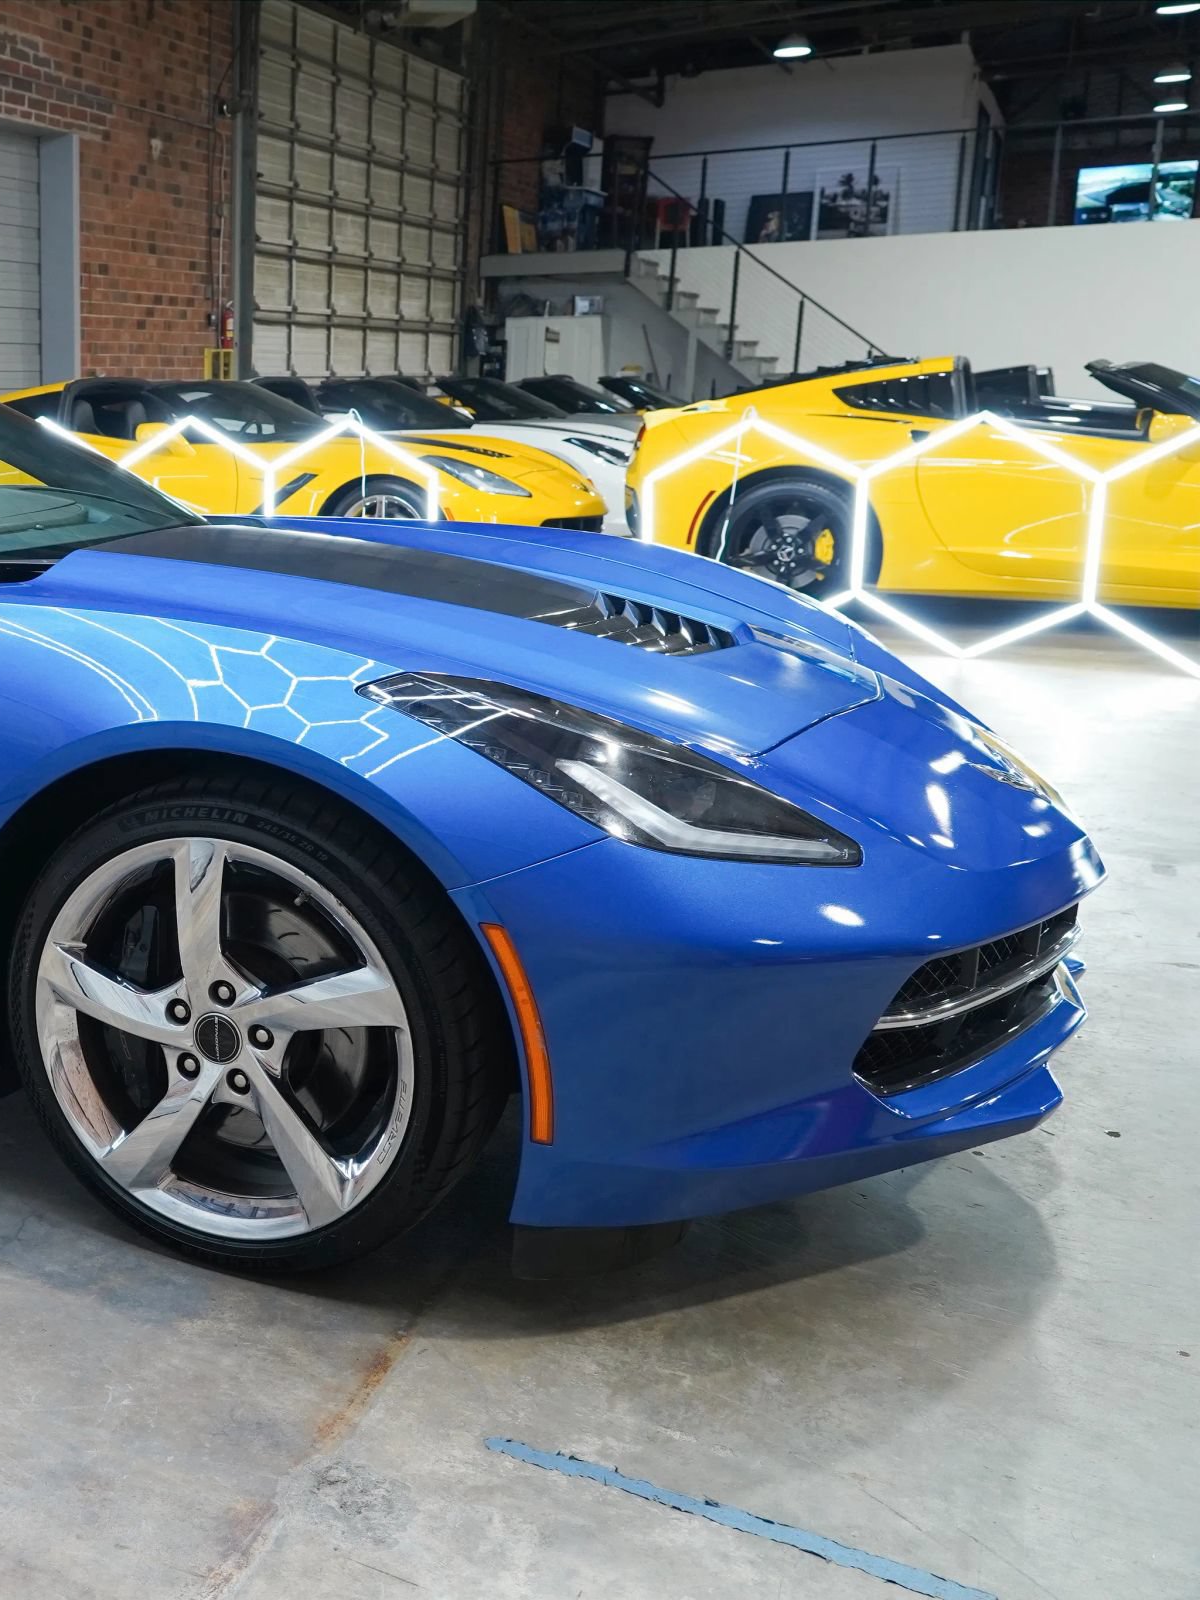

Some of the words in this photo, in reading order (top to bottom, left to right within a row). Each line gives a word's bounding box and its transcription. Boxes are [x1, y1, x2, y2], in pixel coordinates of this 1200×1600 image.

[144, 806, 248, 825] MICHELIN
[257, 820, 298, 843] 245/35
[299, 841, 316, 855] ZR
[376, 1078, 408, 1165] CORVETTE
